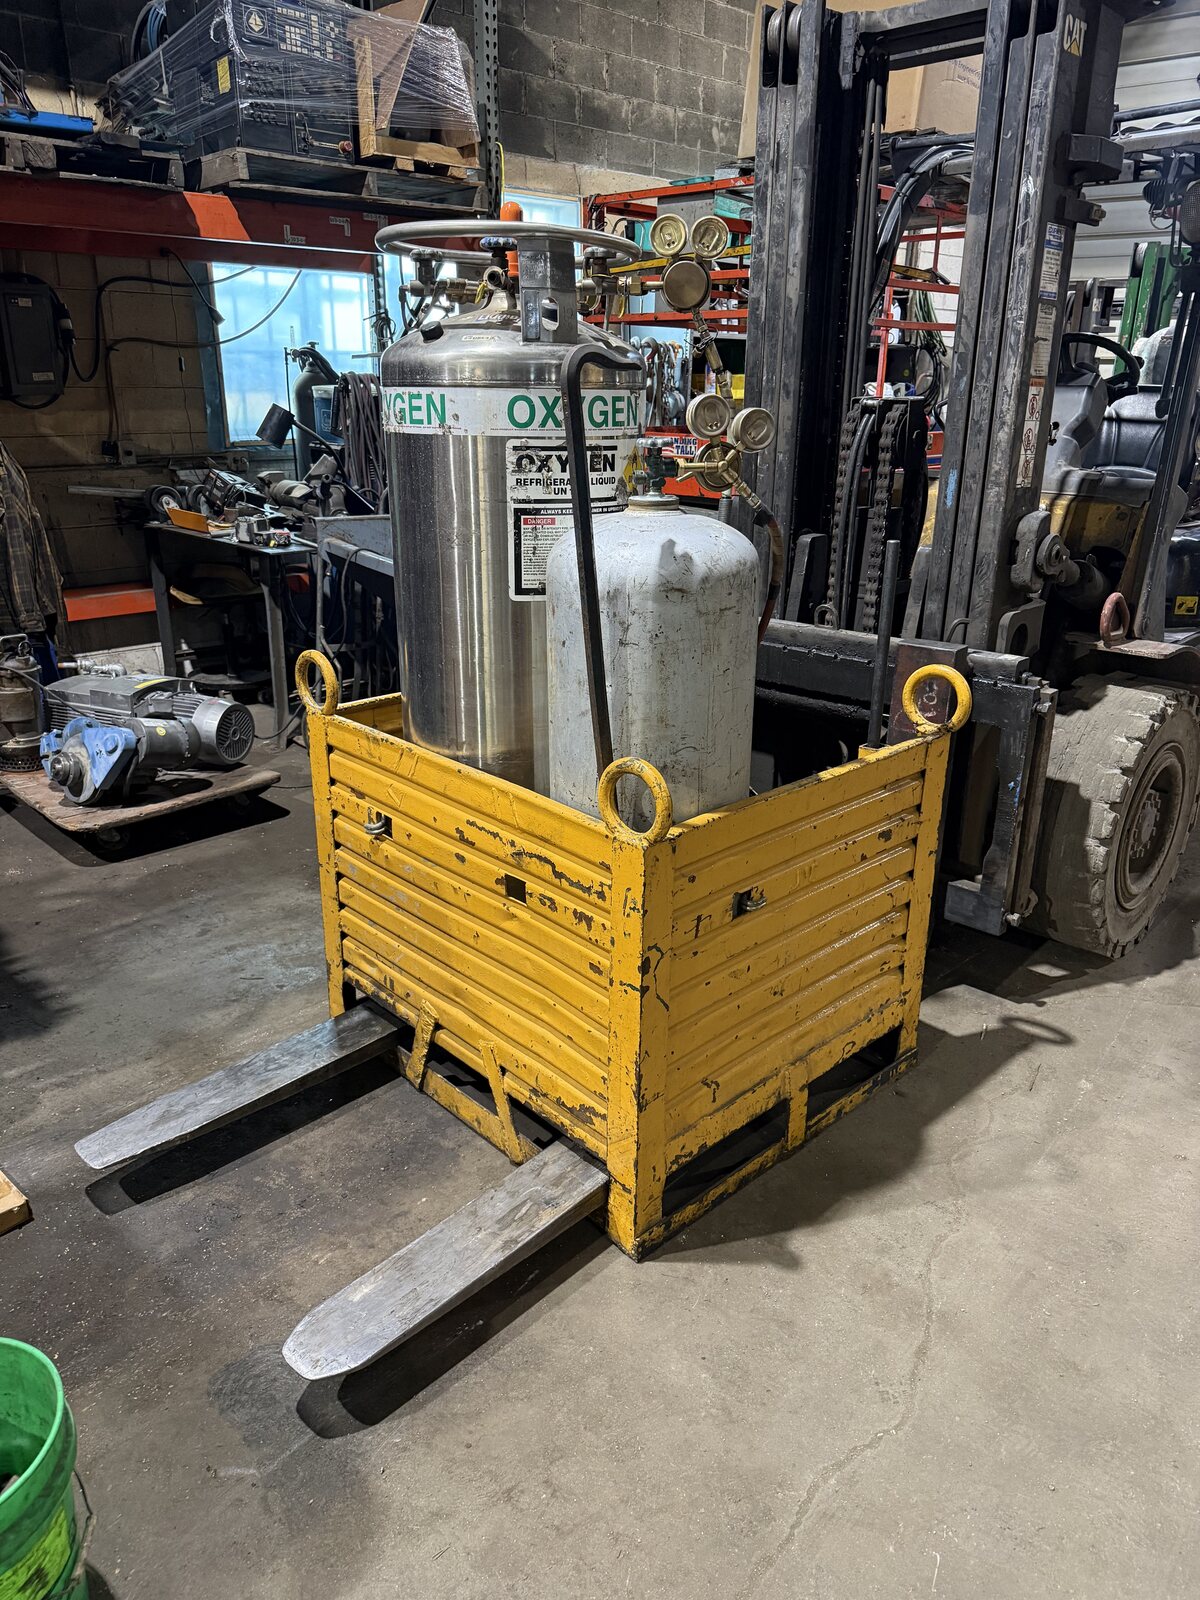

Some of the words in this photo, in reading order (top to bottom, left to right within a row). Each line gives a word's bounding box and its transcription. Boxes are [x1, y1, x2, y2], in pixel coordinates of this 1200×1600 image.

[1063, 13, 1088, 57] CAT
[384, 392, 447, 425] YGEN
[507, 394, 638, 428] OXGEN
[673, 437, 698, 445] NDING
[515, 453, 616, 473] OXYEN
[516, 477, 571, 487] REFRIGERA
[591, 476, 616, 486] LIQUID
[553, 487, 567, 496] UN
